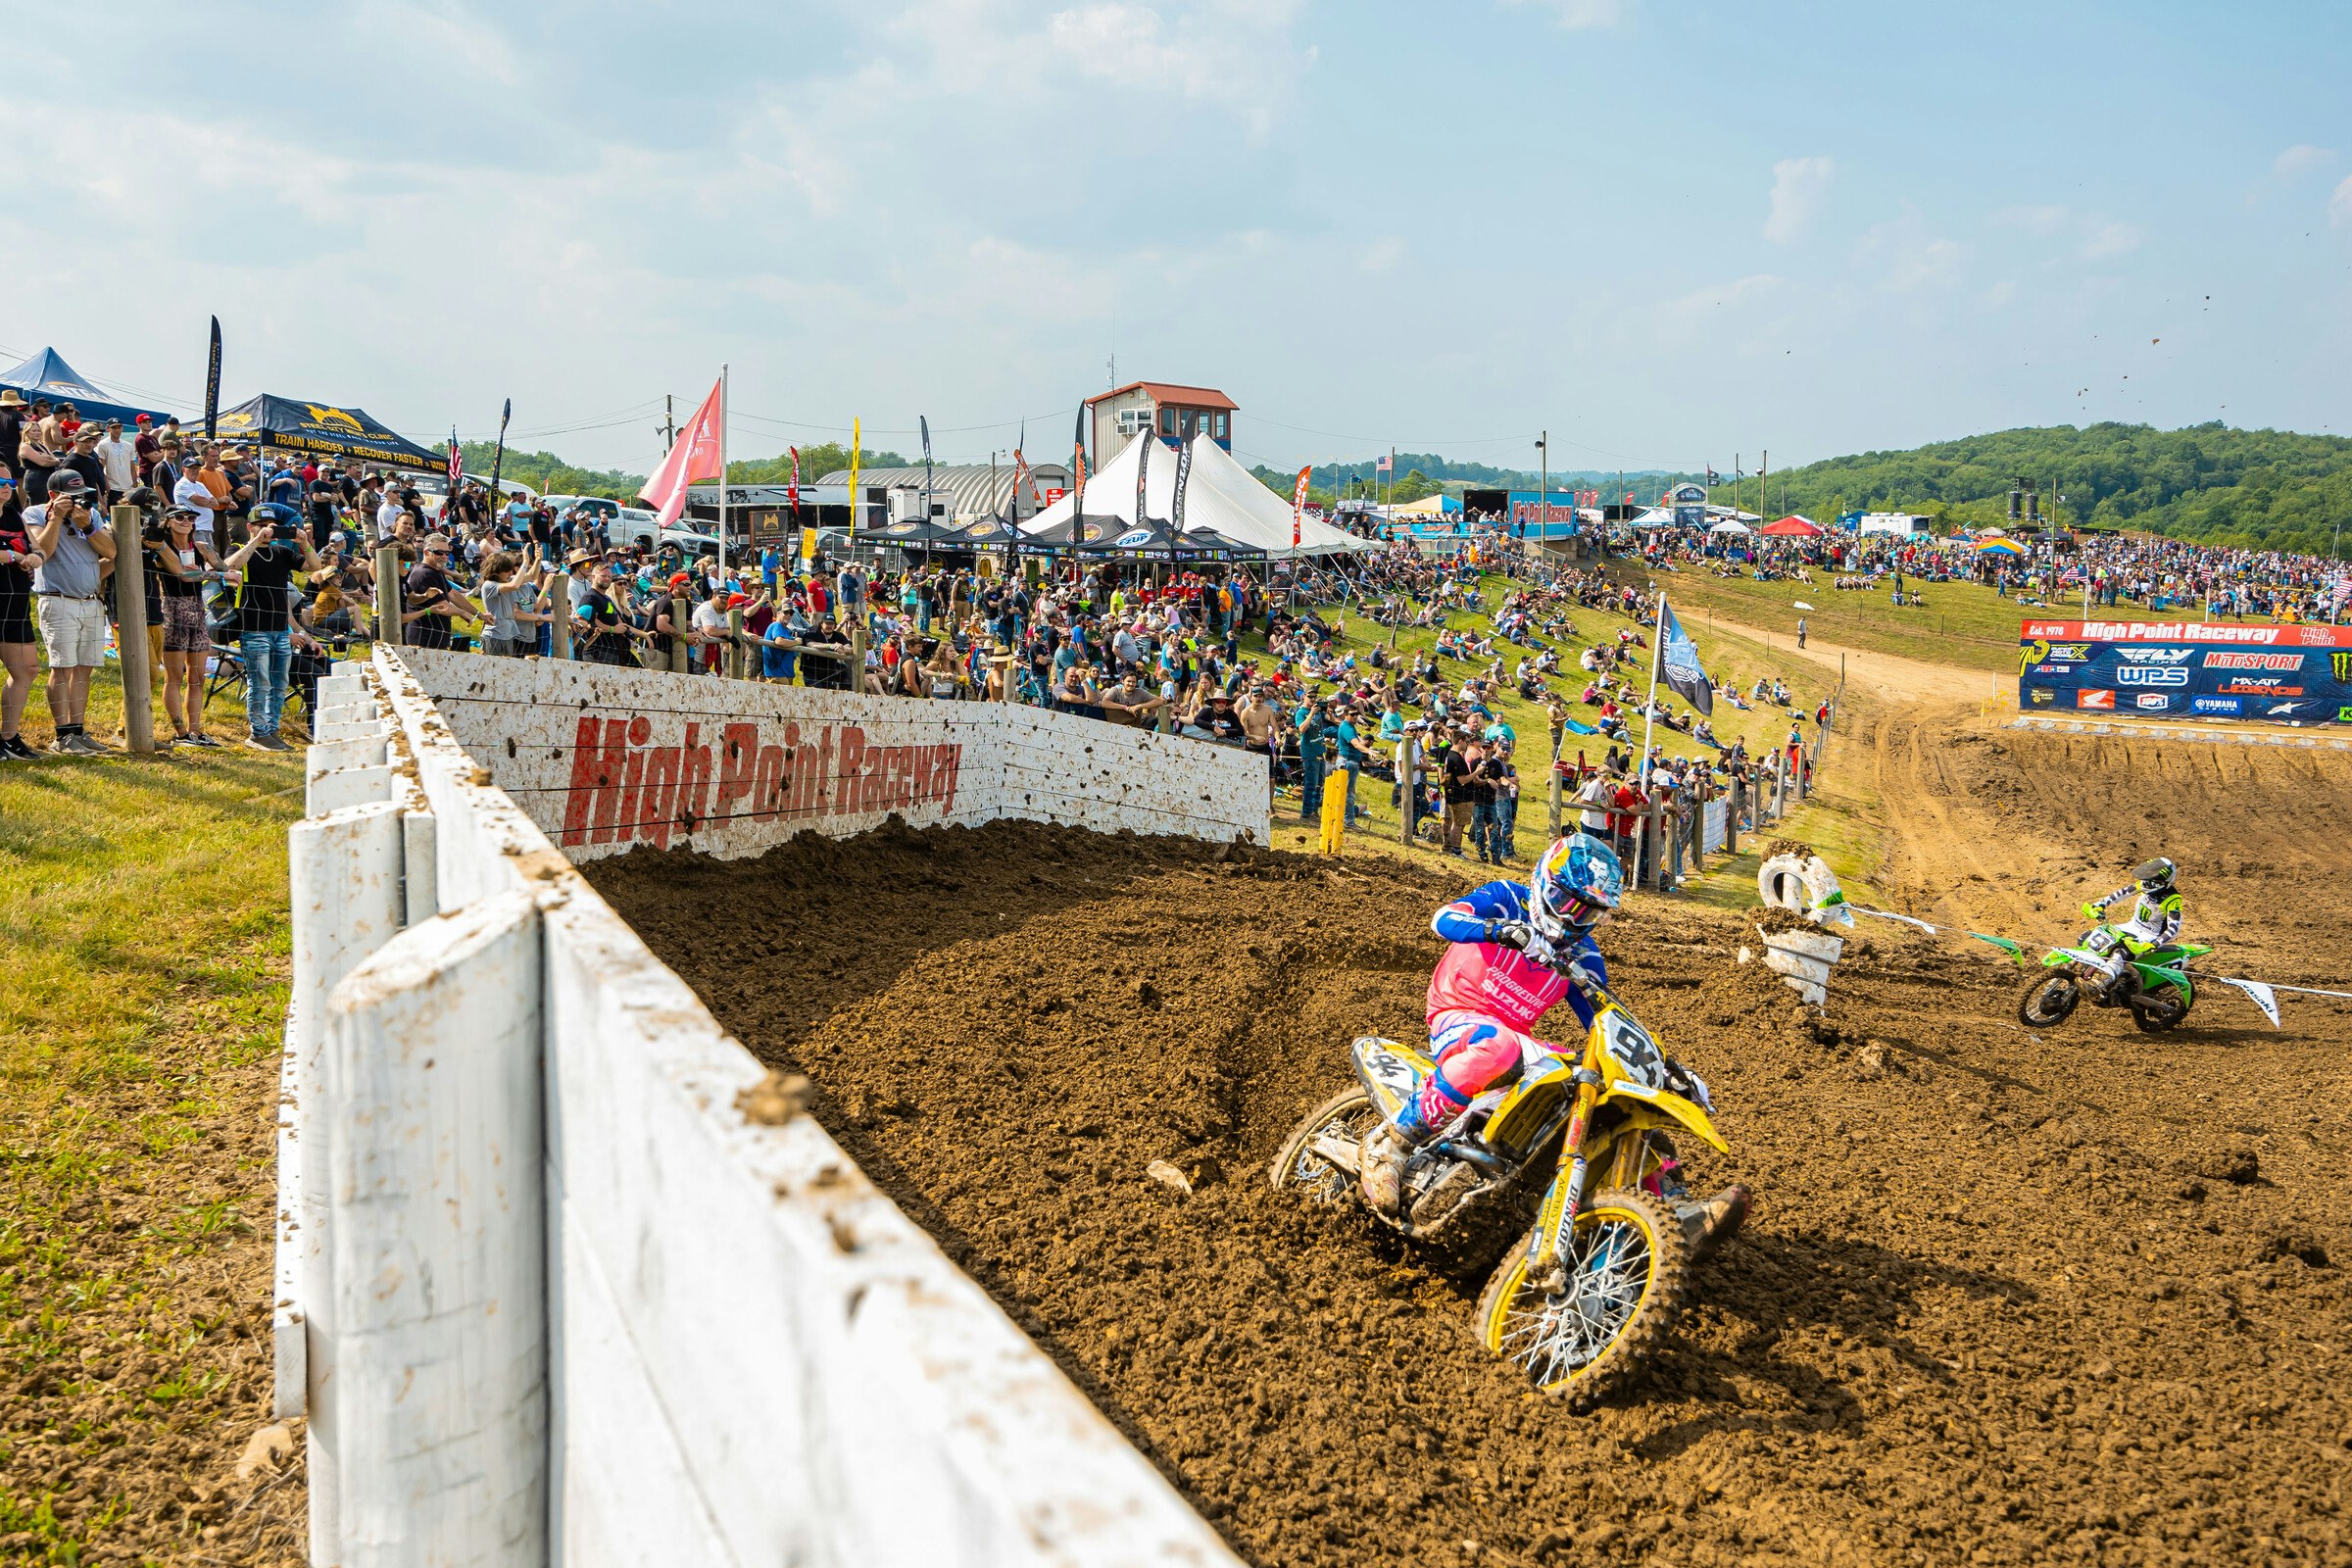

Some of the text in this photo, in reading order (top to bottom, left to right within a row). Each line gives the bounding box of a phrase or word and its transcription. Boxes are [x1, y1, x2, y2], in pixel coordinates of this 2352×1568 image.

[300, 422, 324, 431] STEEL
[368, 432, 394, 441] CLINIC
[274, 433, 305, 449] TRAIN
[307, 438, 345, 454] HARDER
[353, 446, 393, 461] RECOVER
[393, 453, 423, 466] FASTER
[431, 460, 447, 471] WIN
[1546, 501, 1573, 527] Raceway
[2029, 625, 2044, 636] Est.
[2082, 622, 2280, 644] High Point Raceway
[2301, 627, 2329, 638] High
[2302, 635, 2336, 646] Point
[2117, 648, 2195, 662] FLY
[2117, 666, 2189, 687] WPS
[2231, 677, 2282, 686] MX-ATV
[2217, 683, 2304, 697] LEGENDS
[2141, 697, 2165, 707] 100%
[2204, 699, 2238, 710] YAMAHA
[563, 716, 962, 851] High Point Raceway
[2088, 932, 2112, 953] 9
[1486, 965, 1547, 1009] PROGRESSIVE
[1481, 978, 1537, 1021] SUZUKI
[1365, 1053, 1408, 1079] 94
[1610, 1025, 1658, 1090] 94
[1557, 1183, 1580, 1255] DUNLOP
[1530, 1231, 1543, 1253] SKDA
